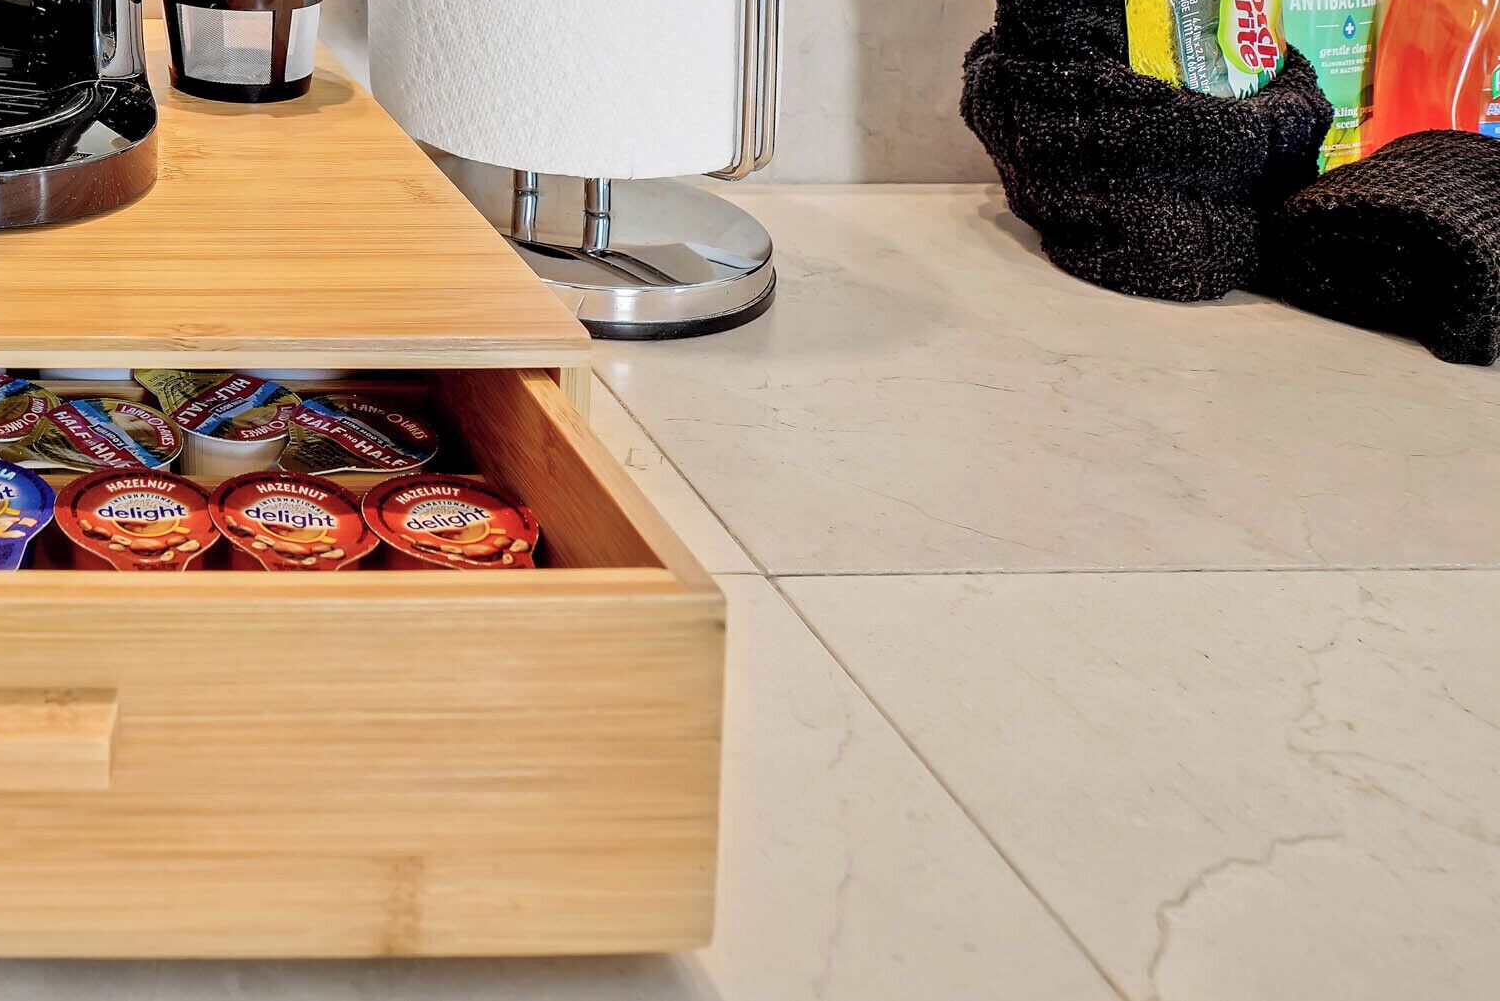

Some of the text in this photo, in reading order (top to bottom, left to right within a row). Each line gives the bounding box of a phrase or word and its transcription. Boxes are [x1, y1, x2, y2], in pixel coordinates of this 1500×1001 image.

[1192, 18, 1202, 31] 4.4
[1193, 31, 1203, 40] IN
[1185, 38, 1195, 54] mm
[1194, 49, 1204, 62] 2.6
[1187, 62, 1197, 73] 66
[1196, 61, 1206, 71] IN
[1333, 106, 1359, 118] kling
[214, 378, 251, 401] HALF
[24, 412, 39, 423] O
[269, 420, 285, 429] O
[387, 413, 403, 423] O
[121, 405, 175, 447] LAND O LAKES
[241, 424, 271, 438] LAKES
[53, 410, 90, 441] HALF
[89, 441, 131, 468] HALF
[295, 412, 347, 437] HALF
[342, 433, 358, 444] AND
[355, 440, 409, 467] HALF
[106, 479, 177, 493] HAZELNUT
[256, 483, 328, 501] HAZELNUT
[110, 493, 175, 506] INTERNATIONAL
[395, 486, 461, 505] HAZELNUT
[98, 505, 187, 521] delight
[258, 497, 324, 516] INTERNATIONAL
[244, 507, 335, 528] delight
[406, 507, 490, 530] delight
